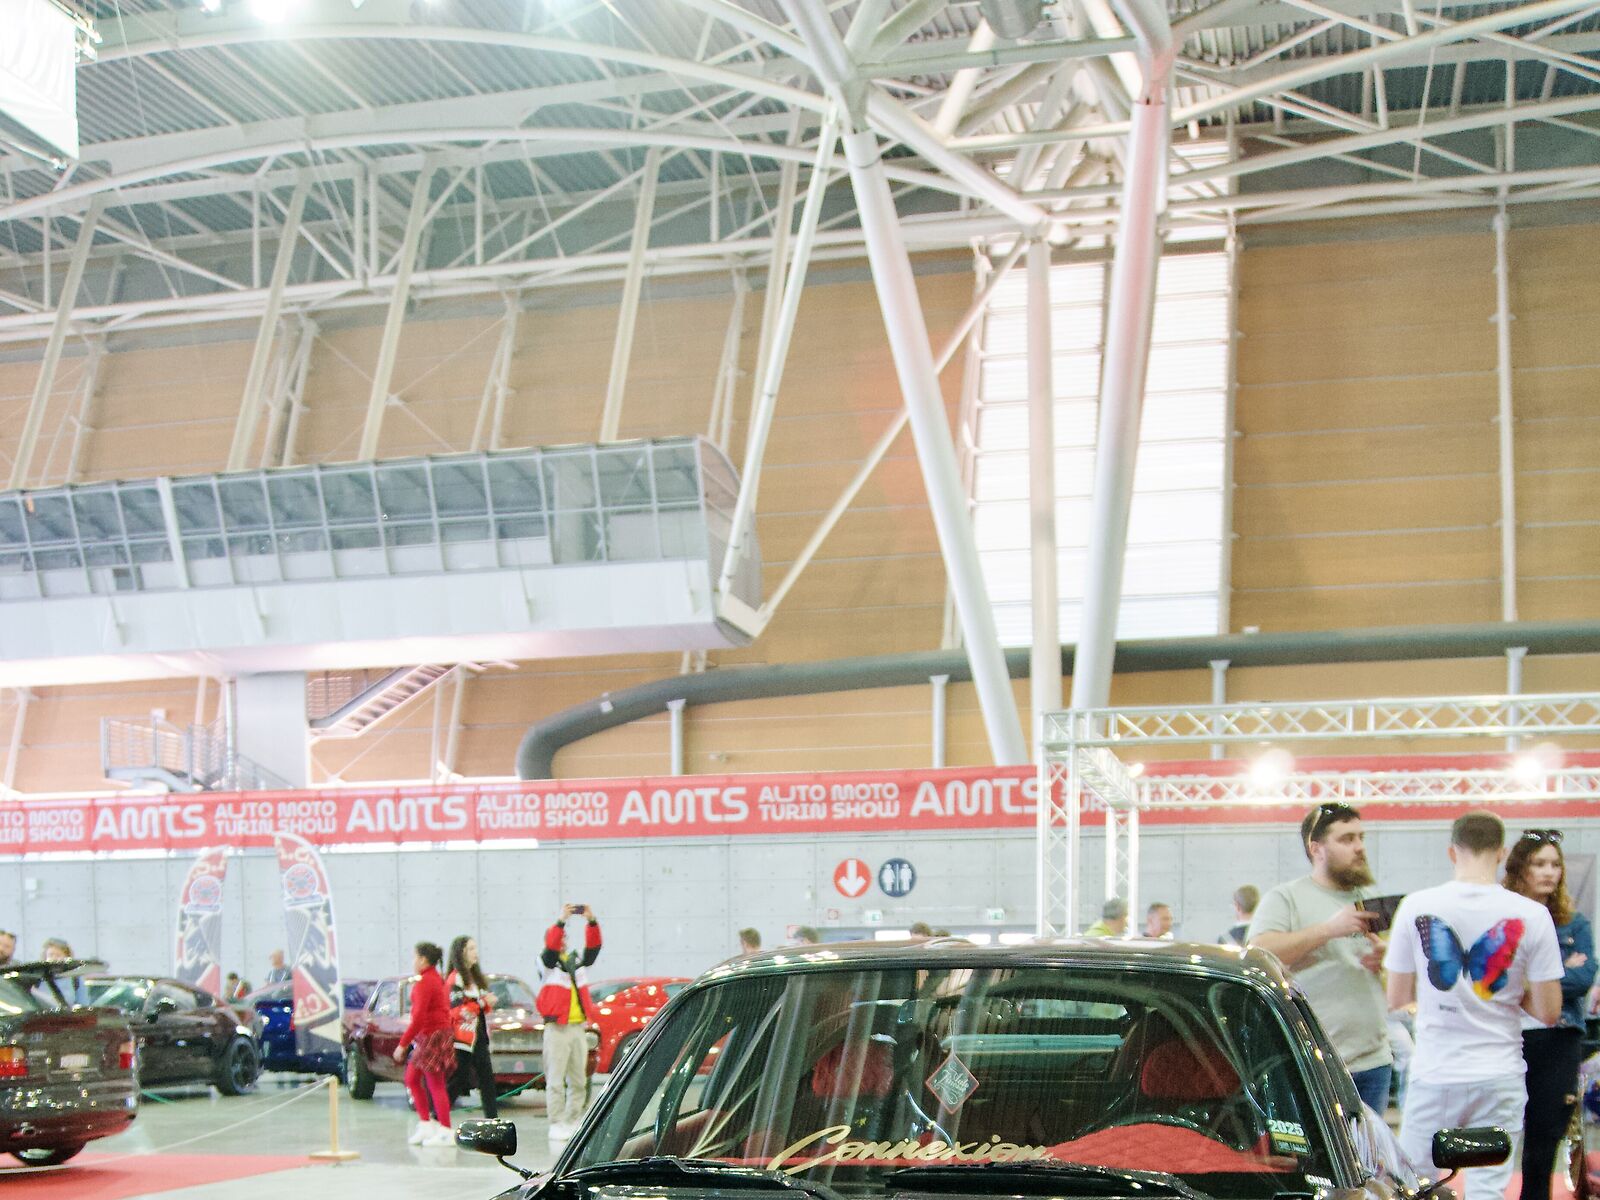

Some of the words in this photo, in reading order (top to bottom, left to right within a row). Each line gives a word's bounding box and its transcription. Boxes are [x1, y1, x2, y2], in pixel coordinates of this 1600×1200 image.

[477, 793, 540, 811] AUTO
[545, 791, 608, 809] MOTO
[758, 784, 827, 802] AUTO
[831, 782, 899, 801] MOTO
[214, 802, 273, 818] AUTO
[277, 801, 337, 817] MOTO
[346, 796, 467, 833] AMTS
[618, 786, 749, 825] AMTS
[758, 801, 827, 821] TURIN
[831, 800, 900, 819] SHOW
[0, 811, 24, 827] TO
[29, 809, 83, 826] MOTO
[92, 803, 206, 841] AMTS
[214, 818, 274, 836] TURIN
[277, 817, 337, 834] SHOW
[477, 810, 541, 829] TURIN
[545, 809, 609, 827] SHOW
[29, 825, 84, 843] SHOW
[1267, 1119, 1305, 1137] 2025
[766, 1124, 1052, 1175] Connexion
